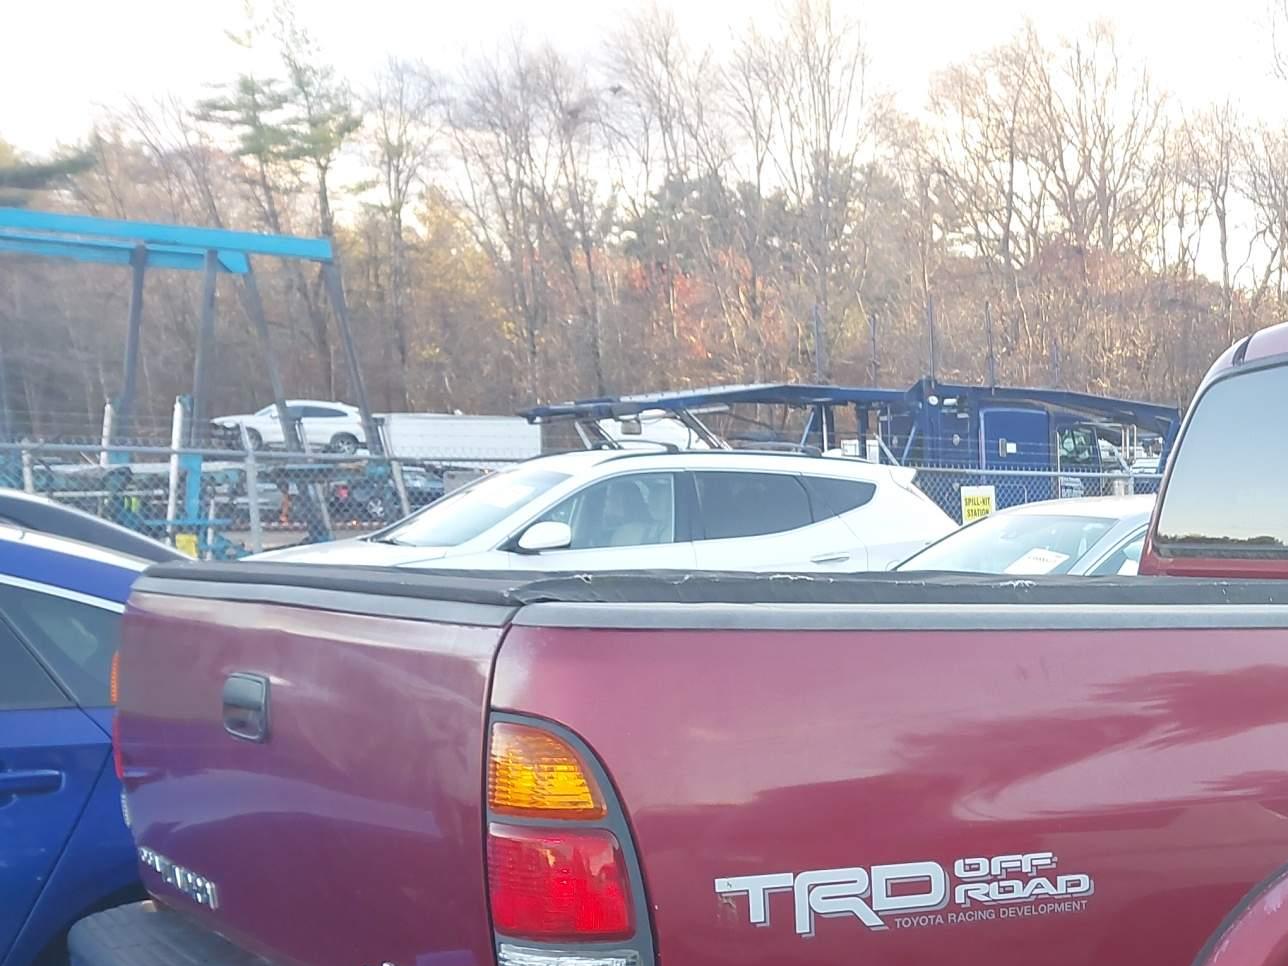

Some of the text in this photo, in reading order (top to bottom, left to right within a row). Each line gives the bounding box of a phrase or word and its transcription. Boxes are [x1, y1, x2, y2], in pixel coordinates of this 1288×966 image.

[964, 495, 991, 507] SPILL-KIT
[966, 508, 990, 518] STATION
[953, 851, 1058, 879] OFF
[714, 861, 949, 938] TRD
[953, 873, 1094, 908] ROAD
[894, 899, 1088, 929] TOYOTA RACING DEVELOPMENT
